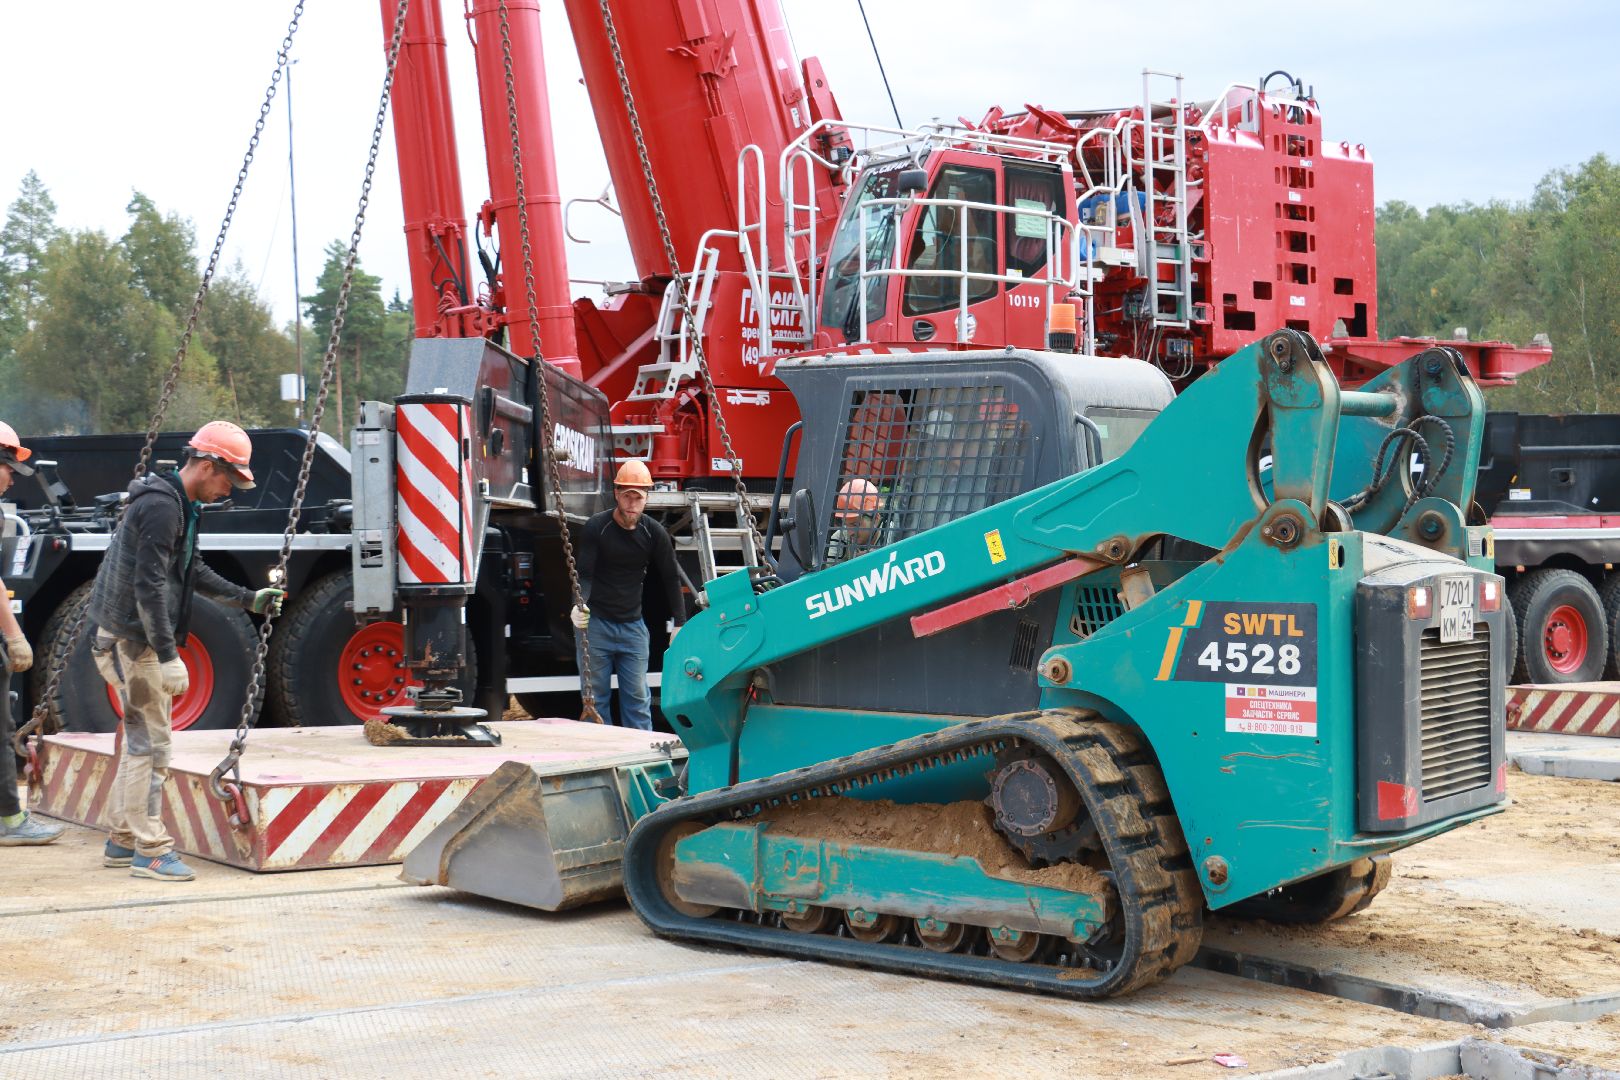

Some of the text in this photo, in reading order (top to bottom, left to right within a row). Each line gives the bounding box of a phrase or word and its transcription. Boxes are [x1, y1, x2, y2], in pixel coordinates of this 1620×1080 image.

[1008, 294, 1040, 308] 10119
[805, 550, 946, 620] SUNWARD
[1445, 580, 1470, 605] 7201
[1223, 612, 1304, 637] SWTL
[1461, 610, 1472, 630] 24
[1197, 641, 1301, 675] 4528
[1268, 689, 1306, 698] МАШИНЕРИ
[1242, 709, 1300, 720] ЗАПЧАСТИ СЕРВИС
[1249, 700, 1292, 710] СПЕЦТЕХНИКА
